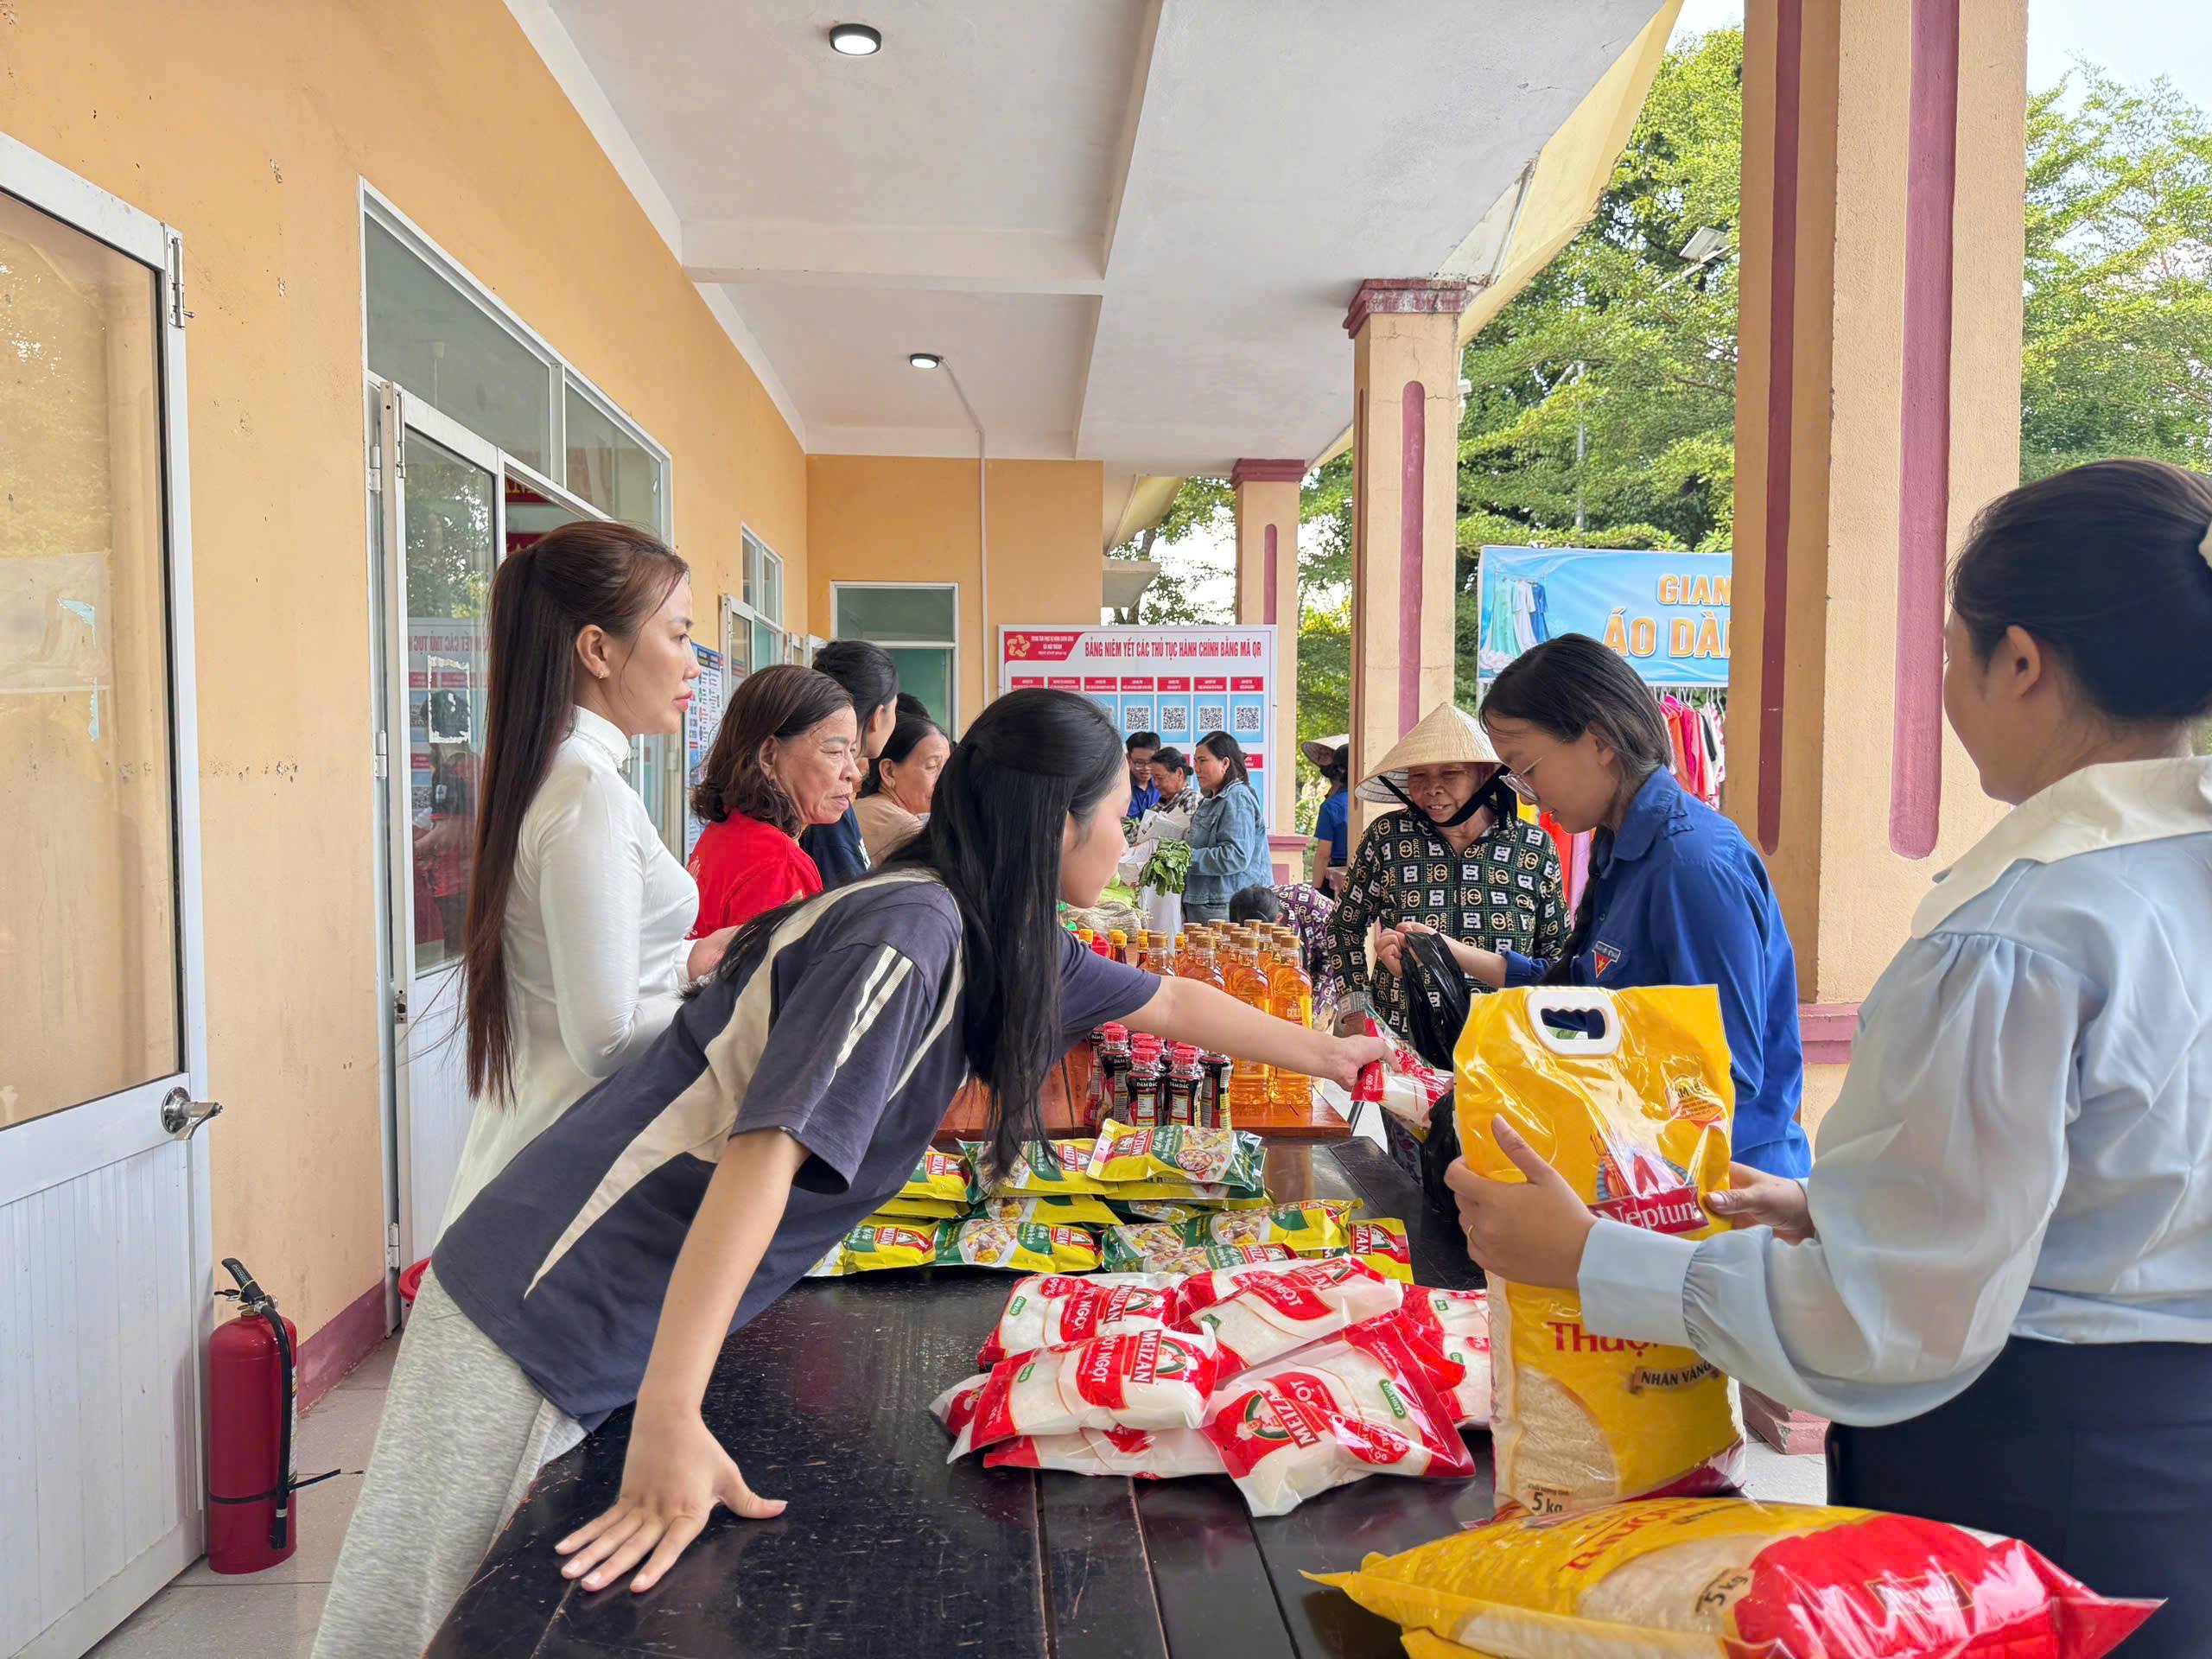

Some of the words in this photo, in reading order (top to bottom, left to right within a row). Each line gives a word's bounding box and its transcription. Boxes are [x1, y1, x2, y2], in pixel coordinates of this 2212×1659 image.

[1085, 637, 1103, 657] BẢNG
[1104, 639, 1122, 657] NIÊM
[1123, 636, 1135, 657] YẾT
[1136, 639, 1150, 657] CÁC
[1152, 636, 1163, 657] THỦ
[1165, 642, 1178, 660] TỤC
[1179, 639, 1198, 657] HÀNH
[1198, 639, 1219, 657] CHÍNH
[1221, 636, 1238, 657] BẰNG
[1240, 639, 1250, 657] MÃ
[1252, 641, 1262, 658] QR
[1603, 607, 1656, 658] ÁO
[1044, 1277, 1059, 1296] 99%
[1071, 1300, 1094, 1332] NGỌT
[1091, 1352, 1114, 1383] NGỌT
[1133, 1331, 1158, 1382] MEIZAN
[1265, 1389, 1316, 1446] MEIZA
[1532, 1491, 1543, 1511] 5
[1546, 1497, 1563, 1514] kg
[1704, 1587, 1726, 1606] 5
[1726, 1574, 1750, 1591] kg
